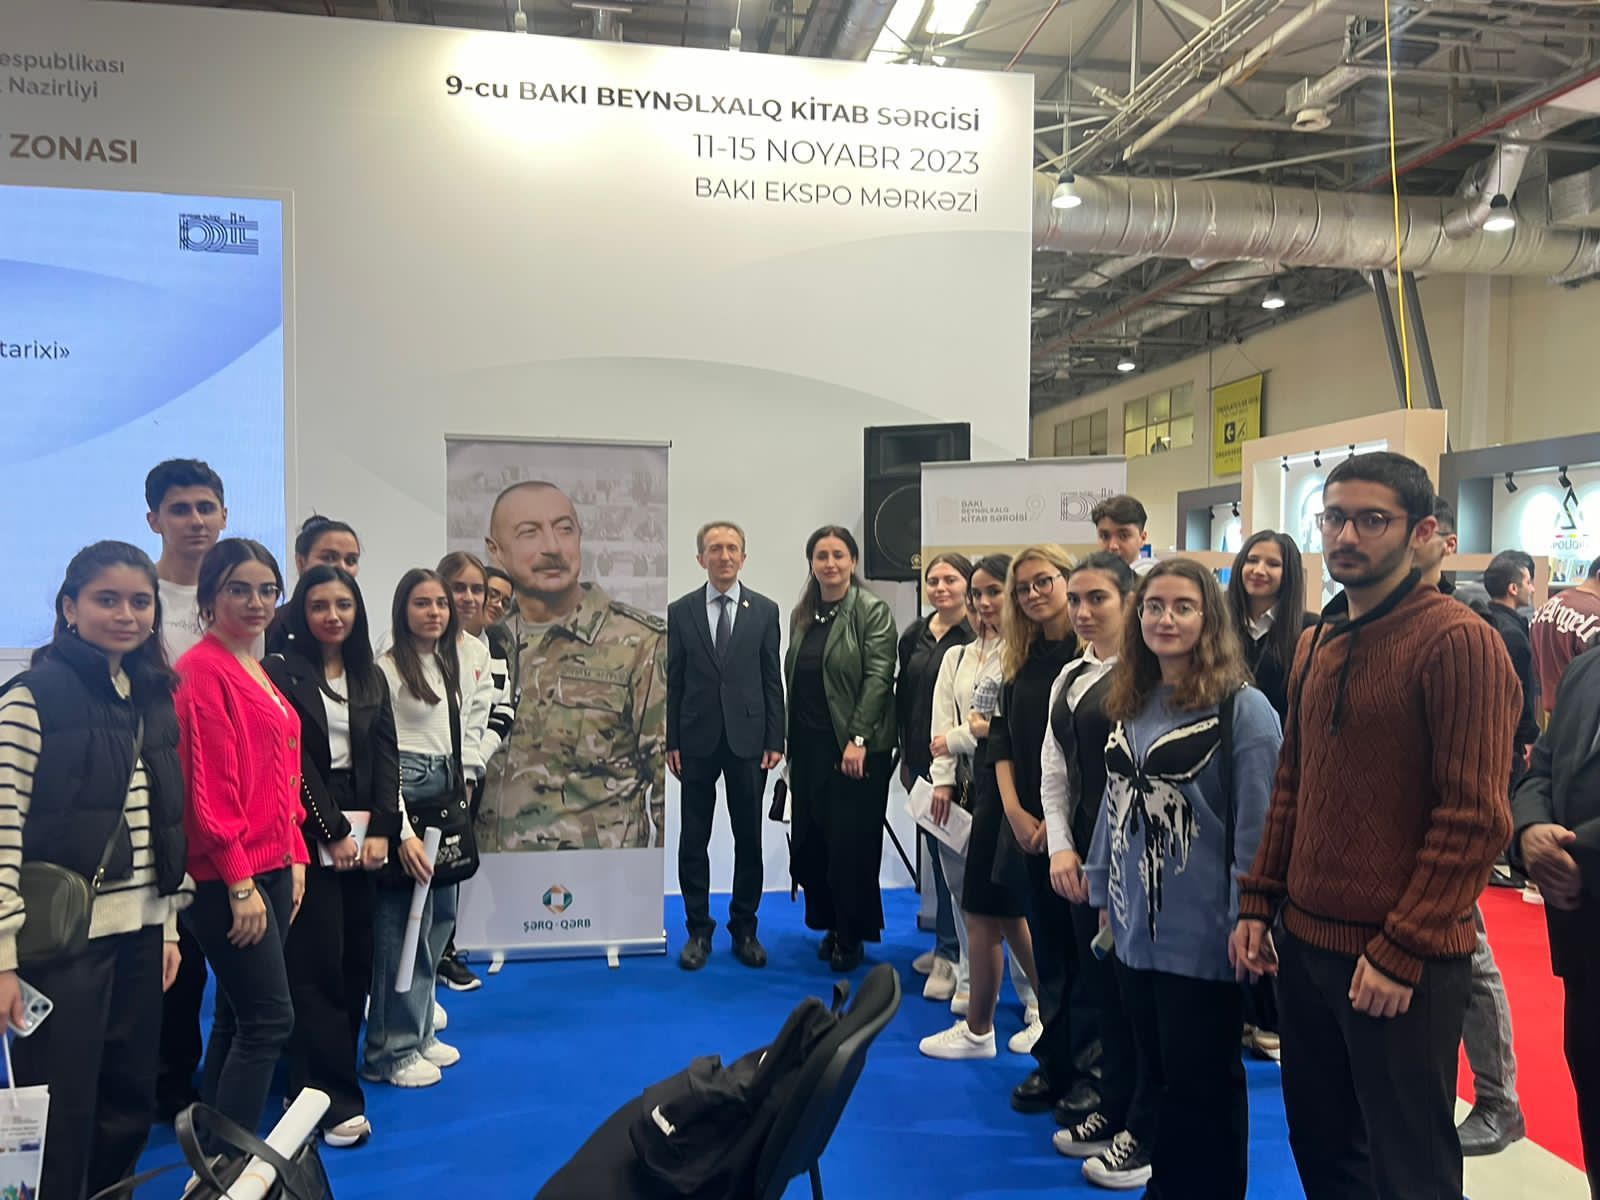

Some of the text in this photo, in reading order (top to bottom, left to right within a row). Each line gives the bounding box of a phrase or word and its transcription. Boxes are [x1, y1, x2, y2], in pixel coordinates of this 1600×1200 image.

[9, 76, 98, 102] Nazirliyi
[445, 75, 980, 131] 9-cu BAKI BEYNƏLXALQ KİTAB SƏRGİSİ
[9, 133, 138, 164] ZONASI
[693, 134, 980, 174] 11-15 NOYABR 2023
[695, 177, 978, 212] BAKI EKSPO MƏRKƏZİ
[0, 340, 70, 360] tarixi»
